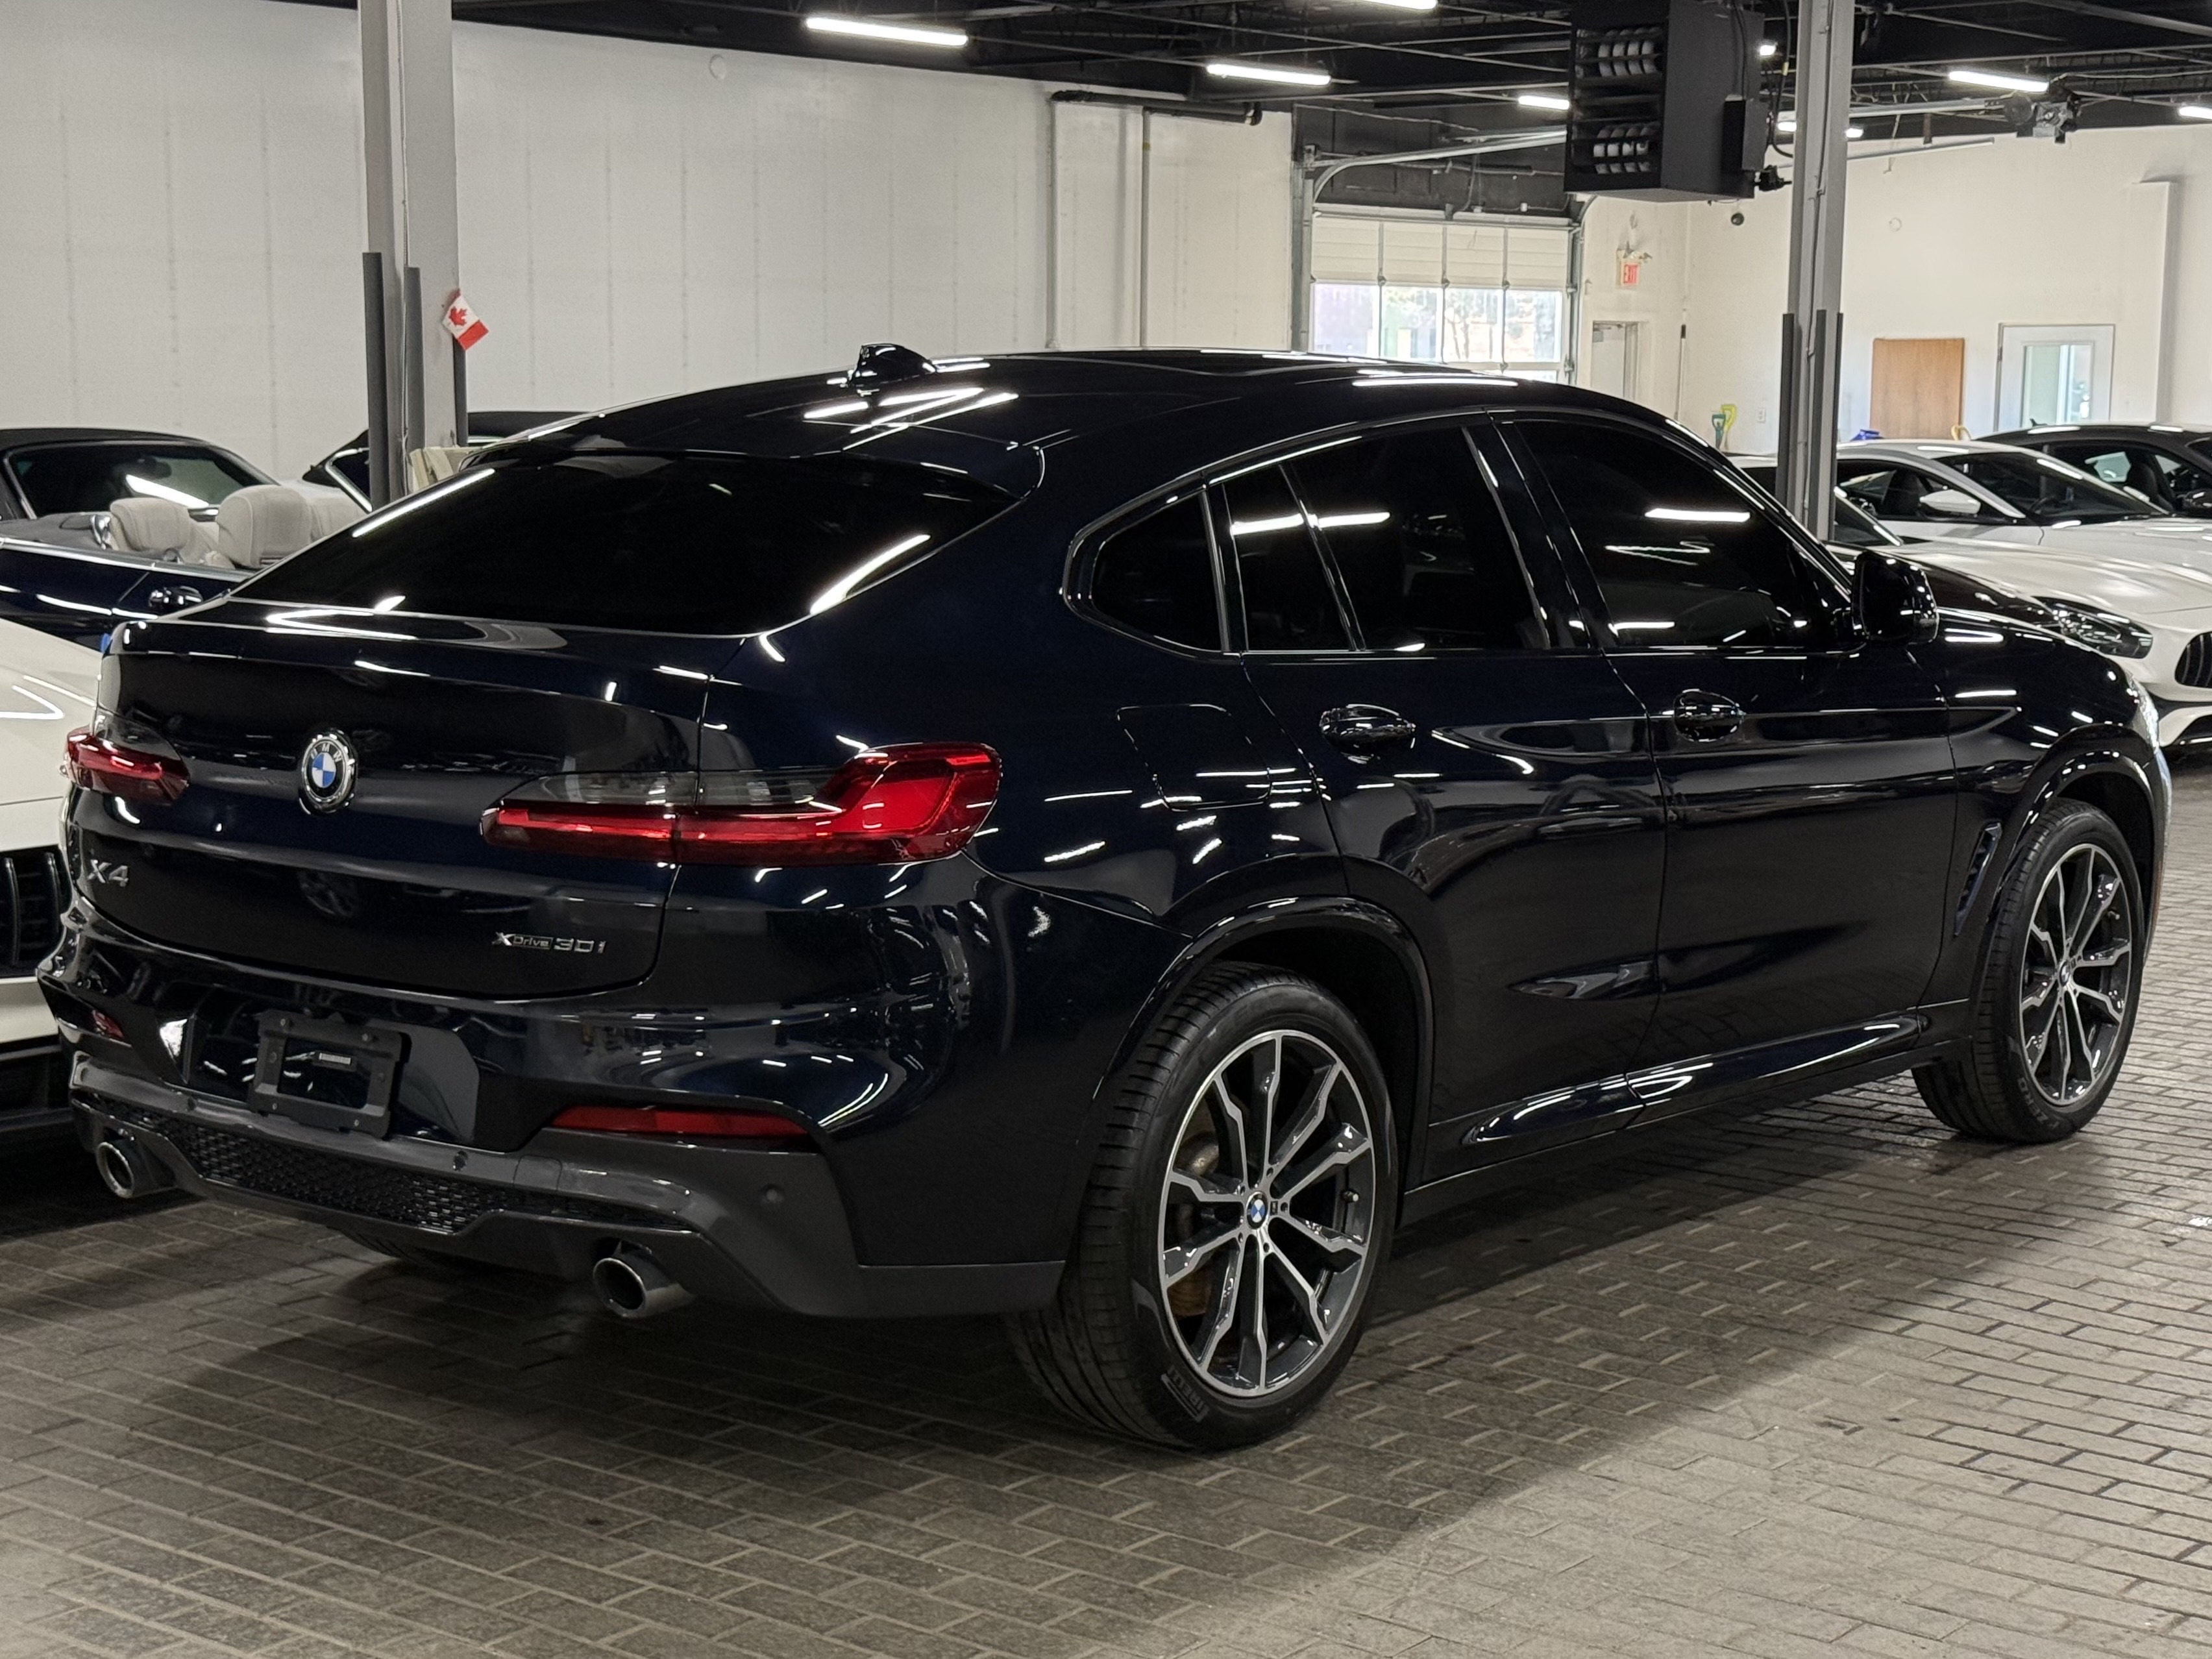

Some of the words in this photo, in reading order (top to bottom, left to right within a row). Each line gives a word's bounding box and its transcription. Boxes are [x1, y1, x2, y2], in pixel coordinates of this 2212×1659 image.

[310, 743, 343, 763] BMW
[88, 859, 129, 887] X4
[1161, 1365, 1210, 1421] PIRELLI
